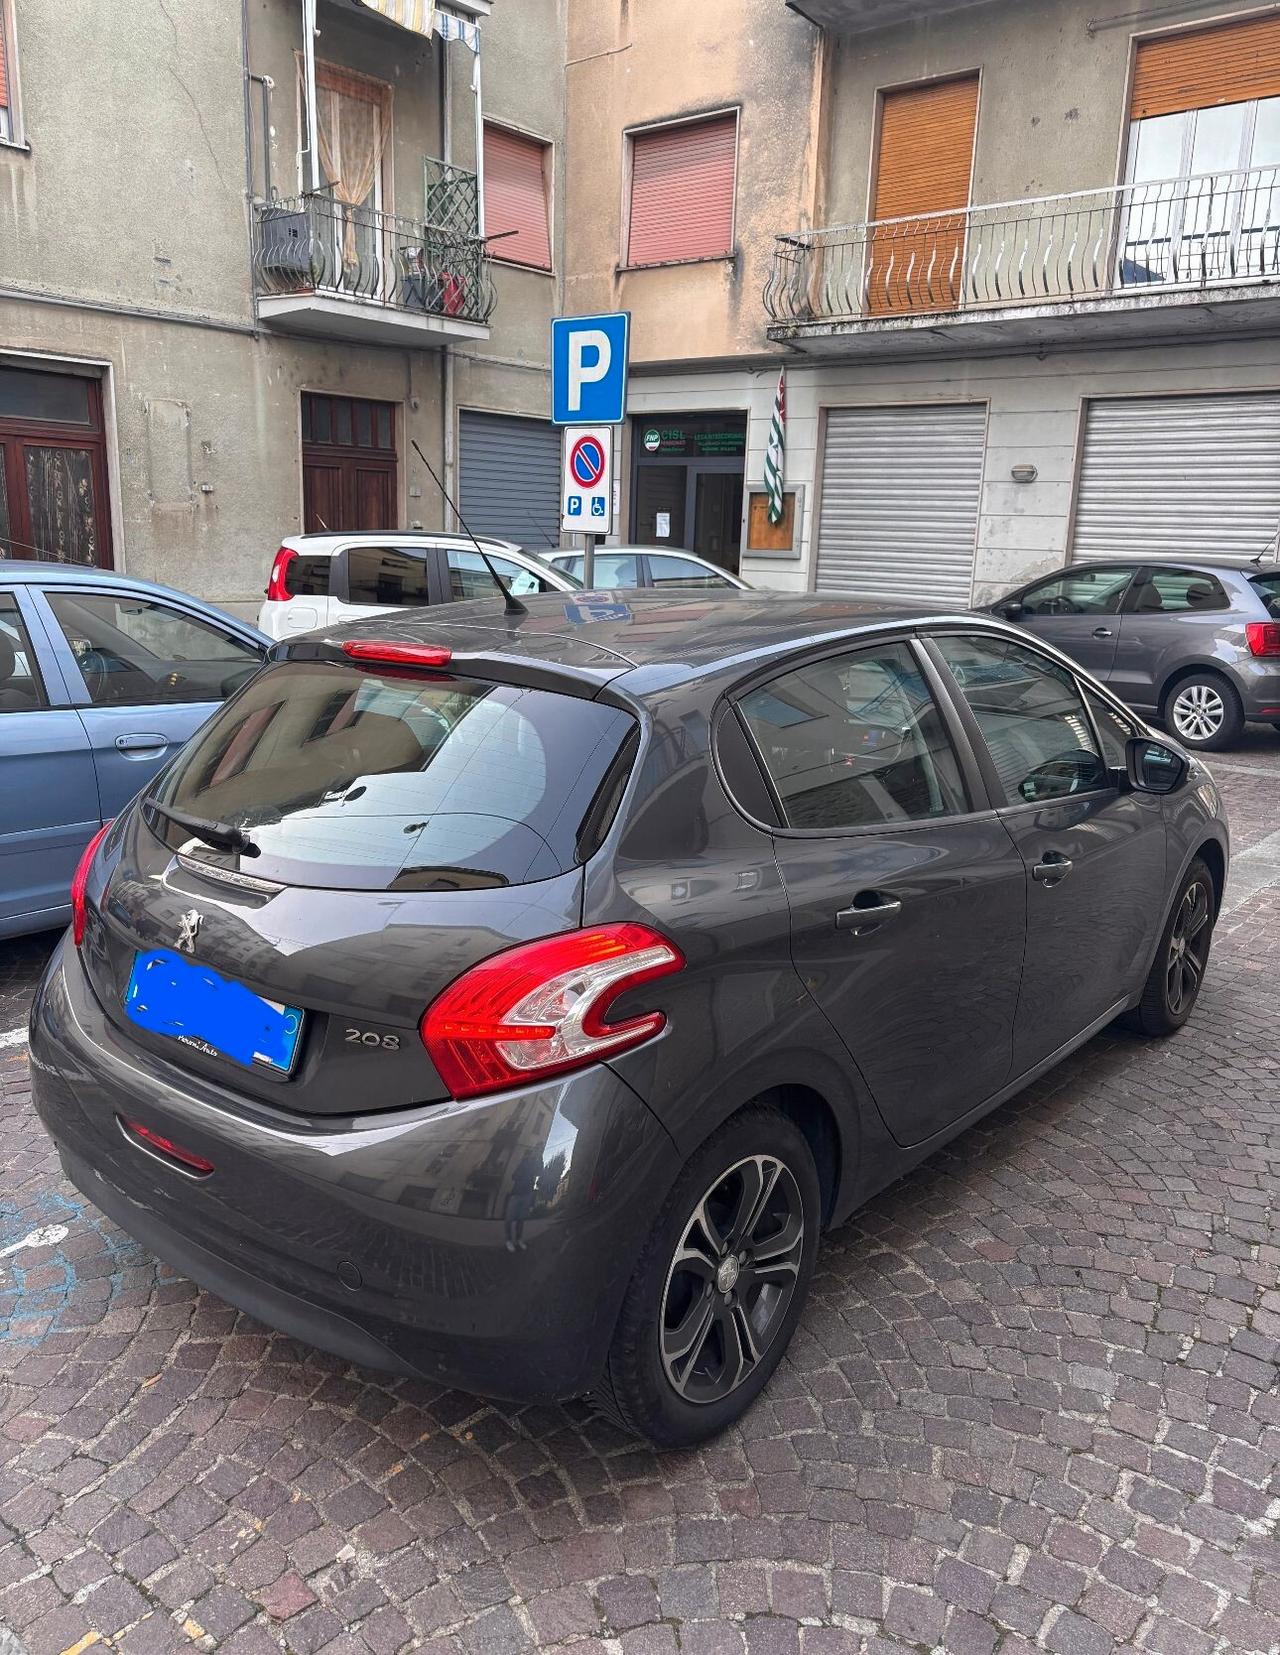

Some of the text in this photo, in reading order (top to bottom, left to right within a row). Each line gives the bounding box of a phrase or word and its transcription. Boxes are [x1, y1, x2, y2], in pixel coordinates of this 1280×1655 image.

[568, 330, 611, 412] P
[646, 434, 659, 442] FNP
[569, 498, 580, 514] P
[344, 1028, 400, 1051] 208
